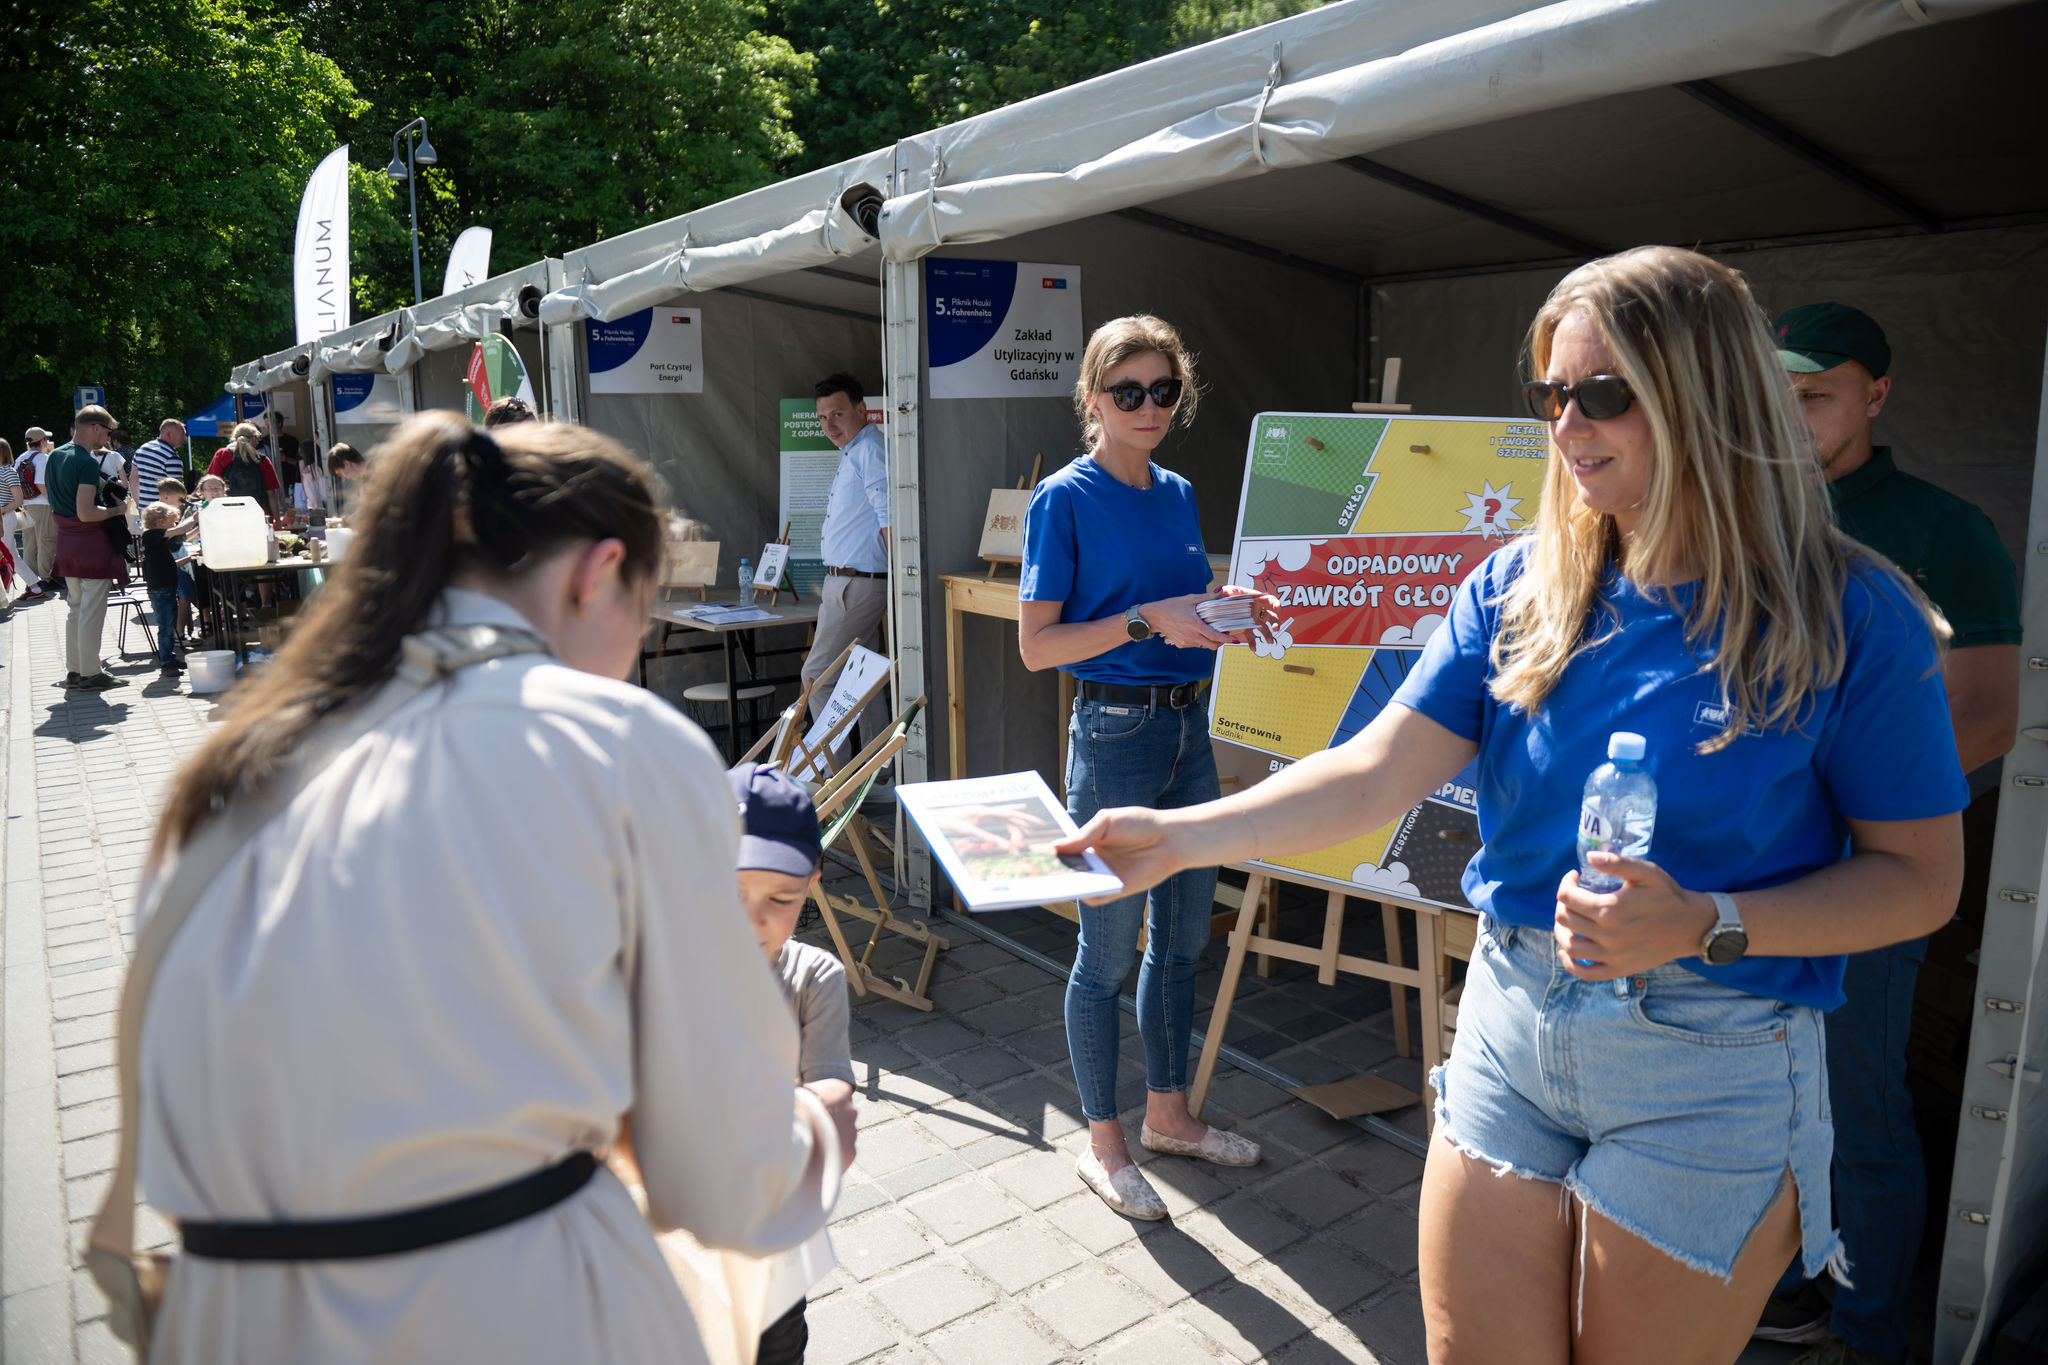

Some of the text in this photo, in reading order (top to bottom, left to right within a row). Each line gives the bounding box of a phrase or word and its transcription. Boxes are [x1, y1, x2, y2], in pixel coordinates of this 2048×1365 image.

[935, 297, 951, 316] 5.
[951, 298, 992, 307] Piknik Nauki
[951, 308, 992, 317] Fahrenheita
[592, 329, 604, 341] 5.
[1014, 329, 1052, 341] Zakład
[994, 349, 1075, 364] Utylizacyjny w
[650, 363, 692, 372] Port Czystej
[659, 374, 683, 382] Energii
[1010, 369, 1059, 381] Gdańsku
[80, 388, 99, 407] P
[1490, 437, 1495, 446] I
[1497, 448, 1548, 459] SZTUCZN
[1338, 484, 1365, 527] SZKŁO
[1327, 553, 1464, 575] ODPADOWY
[1277, 579, 1384, 608] ZAWRÓT
[1215, 726, 1244, 740] Rudniki
[1217, 717, 1282, 742] Sorterownia
[1581, 811, 1600, 836] VA
